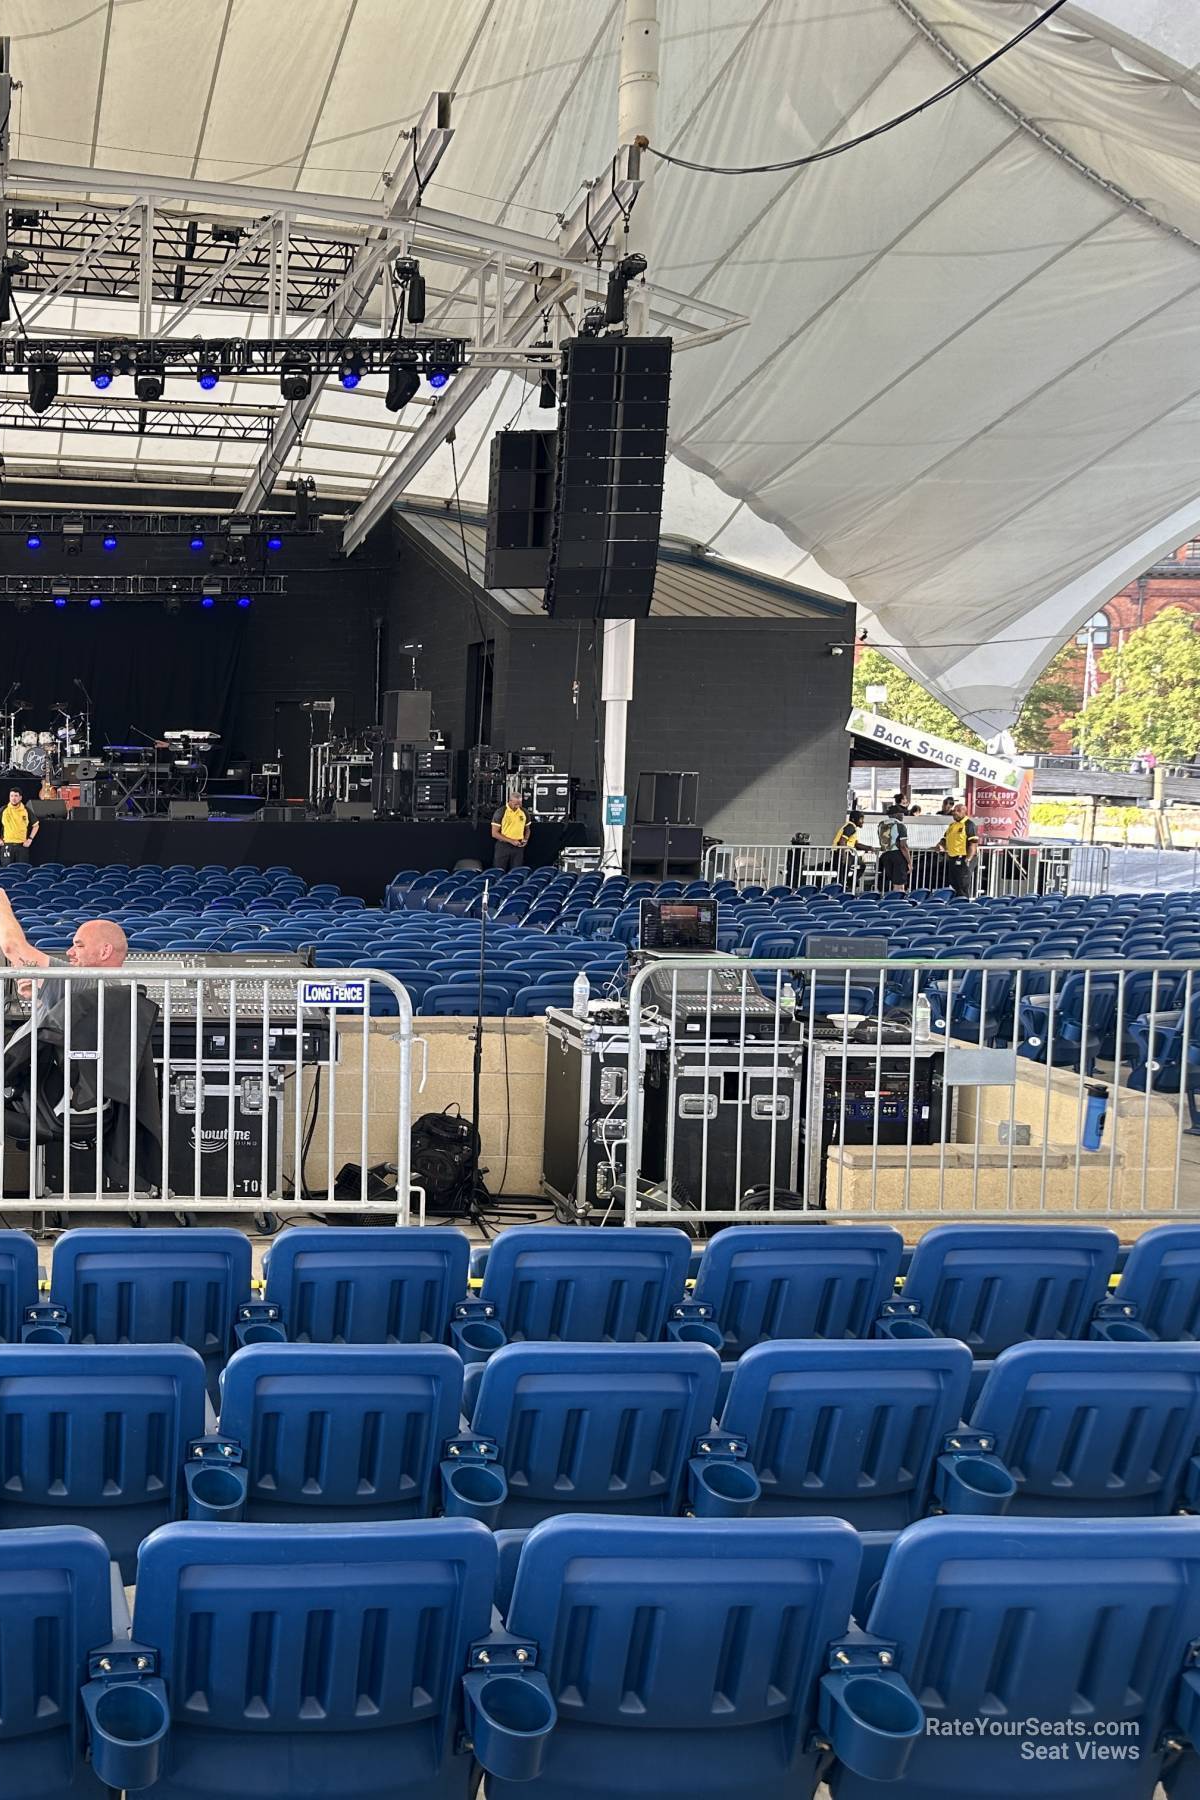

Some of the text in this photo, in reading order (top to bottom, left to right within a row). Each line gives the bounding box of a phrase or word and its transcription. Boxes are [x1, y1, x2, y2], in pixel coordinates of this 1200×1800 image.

[873, 724, 998, 781] BACK STAGE BAR
[977, 791, 1016, 799] DEEP EDDY
[305, 985, 363, 1001] LONG FENCE
[190, 1126, 251, 1141] Showtme
